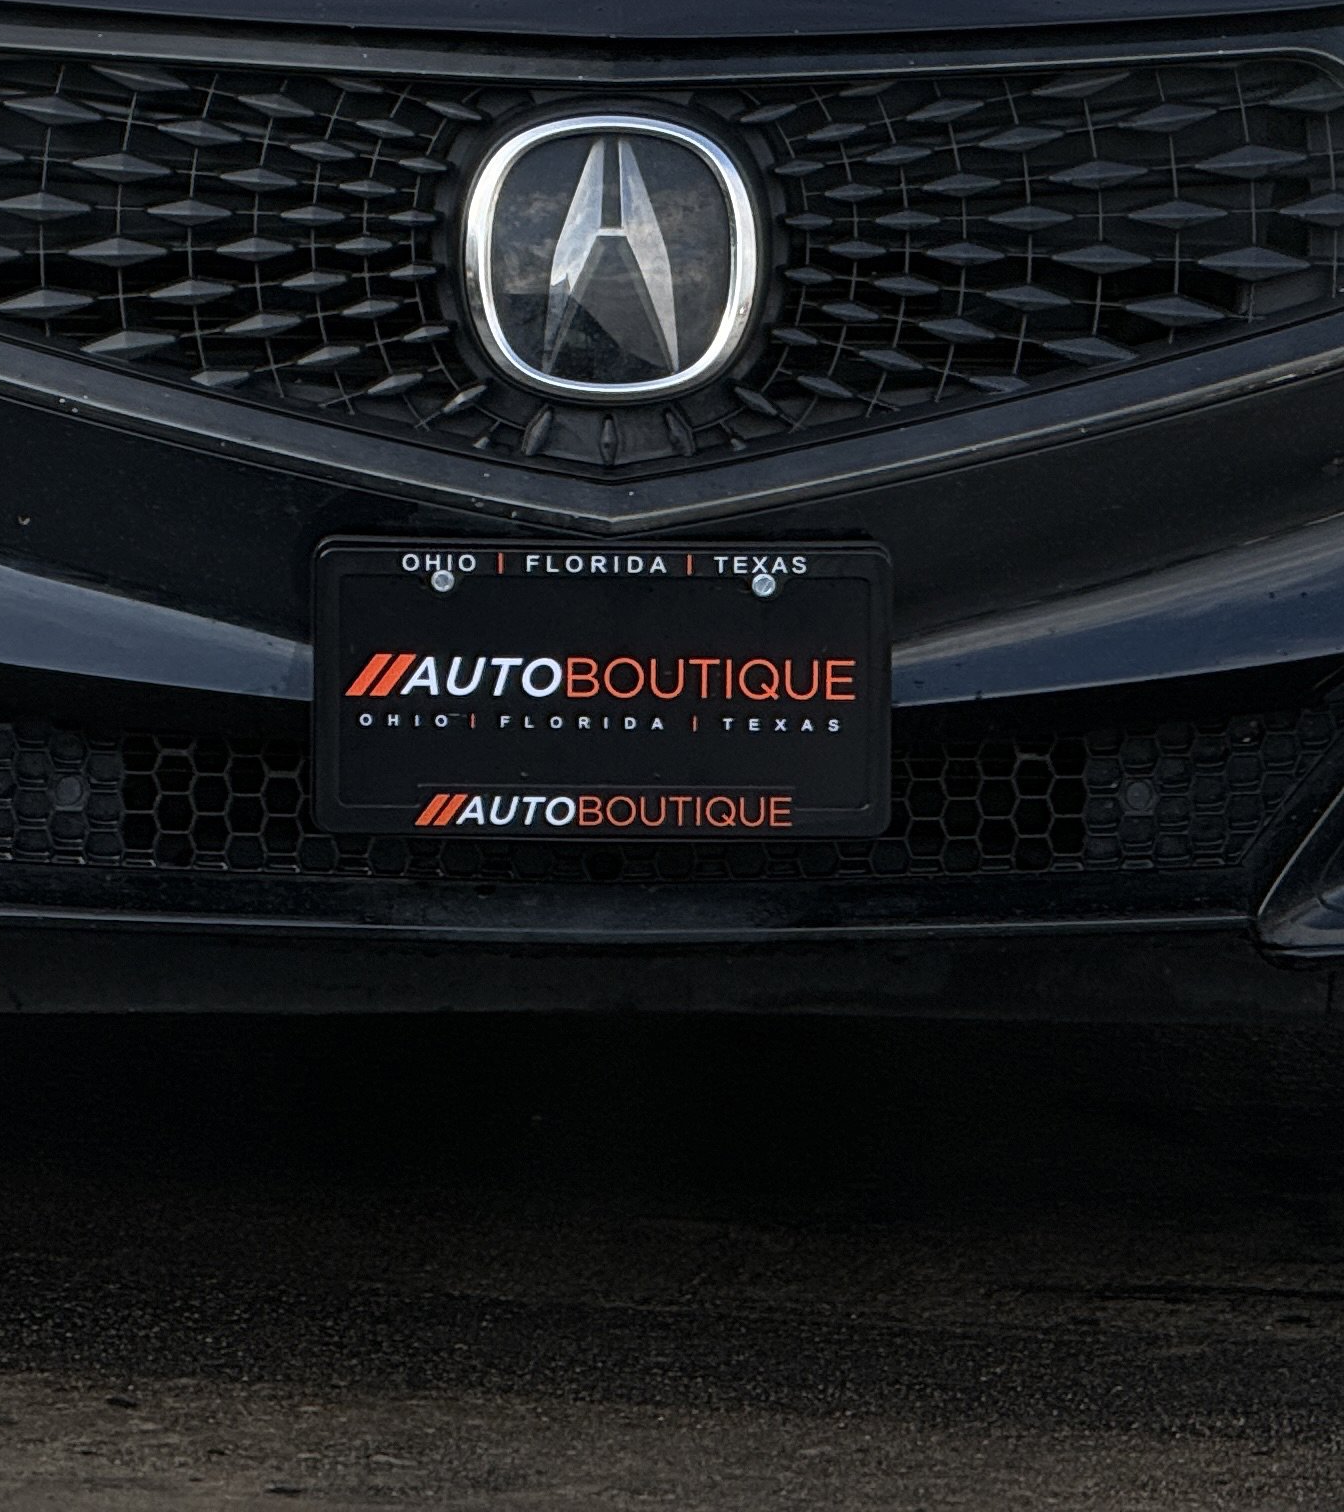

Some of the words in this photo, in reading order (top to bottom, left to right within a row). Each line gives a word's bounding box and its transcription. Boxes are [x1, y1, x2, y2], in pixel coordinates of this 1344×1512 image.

[401, 553, 477, 572] OHIO
[525, 554, 667, 574] FLORIDA
[713, 555, 808, 575] TEXAS
[400, 656, 856, 702] AUTOBOUTIQUE
[359, 713, 449, 728] OHIO
[499, 714, 665, 731] FLORIDA
[722, 717, 841, 732] TEXAS
[455, 795, 793, 827] AUTOBOUTIQUE
